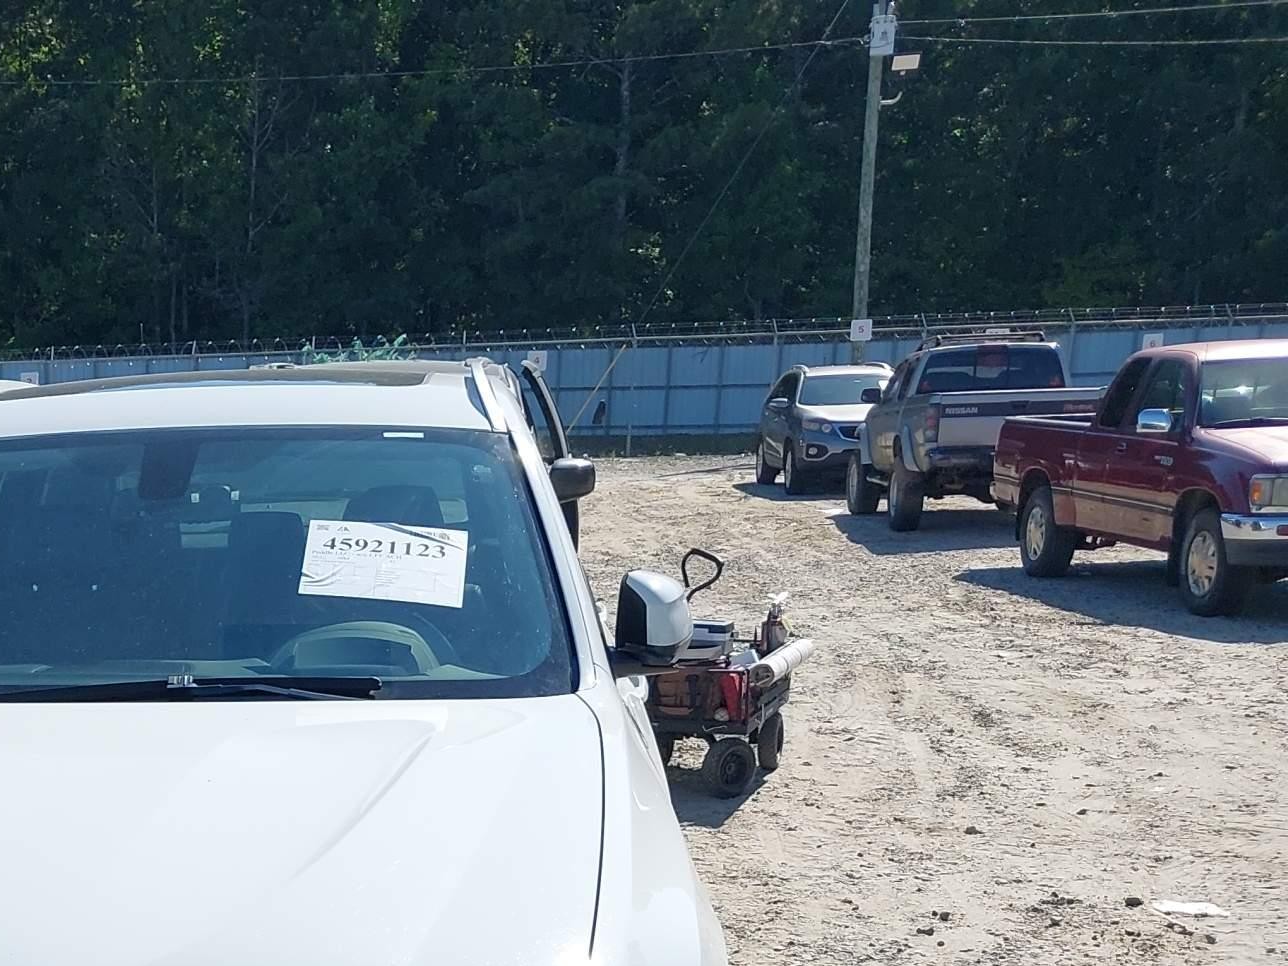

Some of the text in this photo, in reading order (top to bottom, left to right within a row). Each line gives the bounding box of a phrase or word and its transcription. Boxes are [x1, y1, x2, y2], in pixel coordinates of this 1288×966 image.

[858, 325, 865, 334] 5
[944, 406, 979, 415] NISSAN
[323, 536, 446, 559] 45921123
